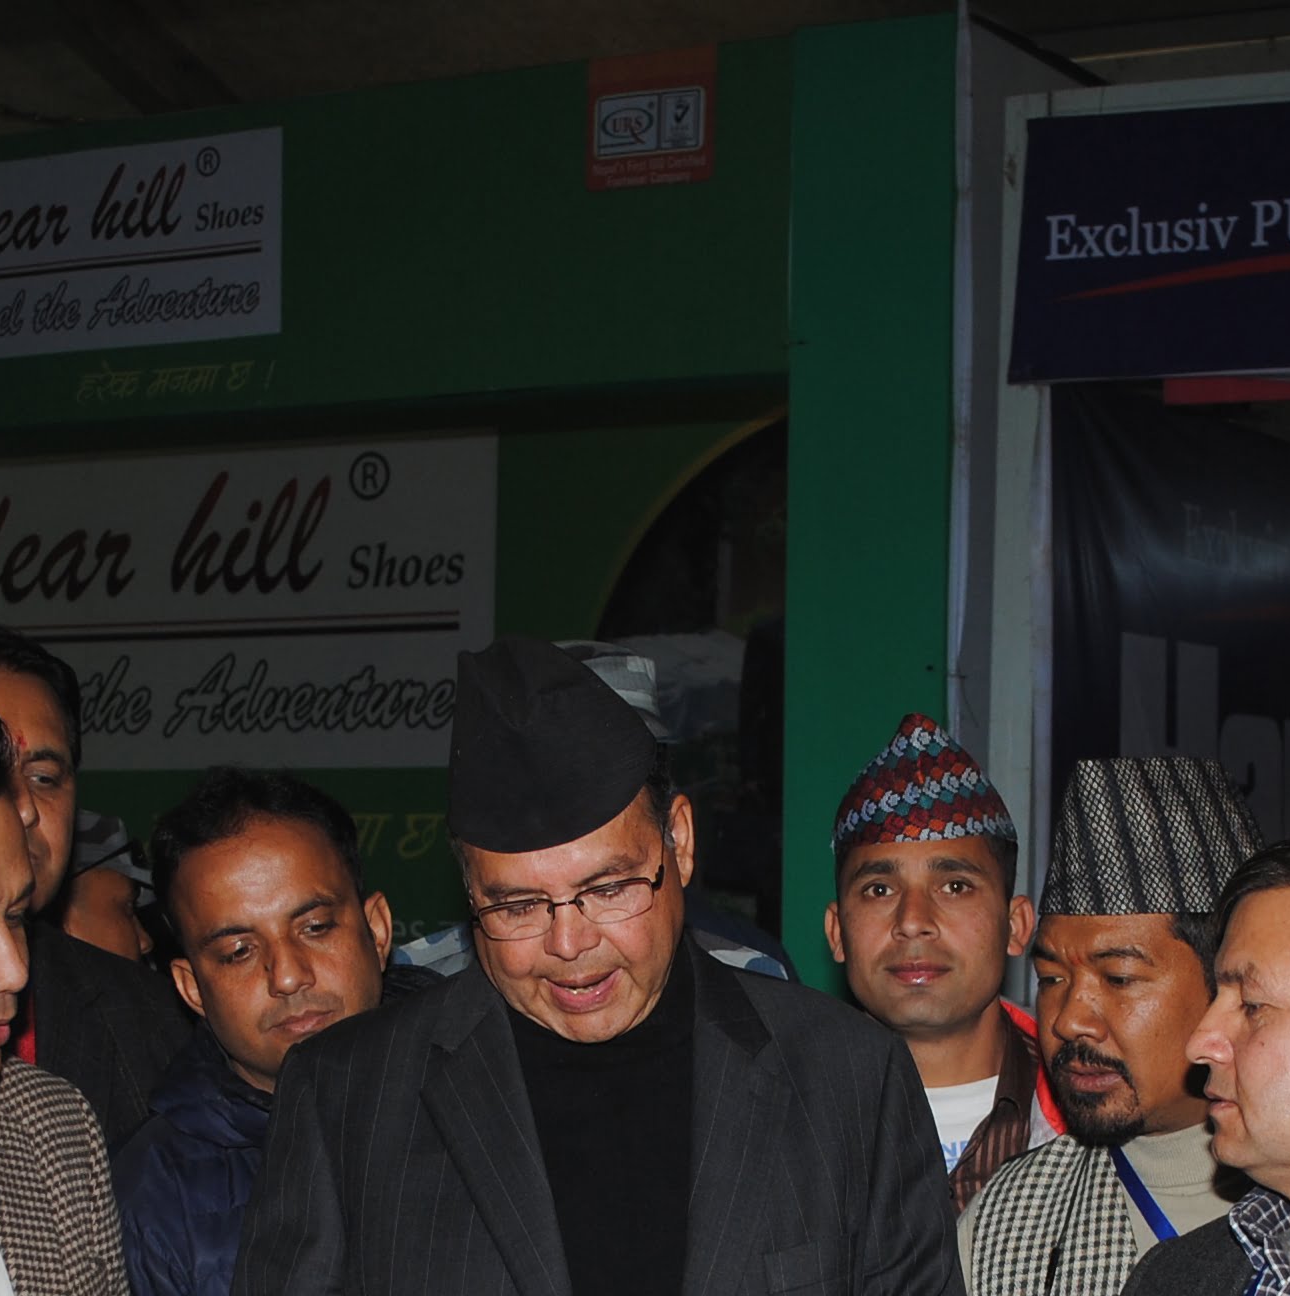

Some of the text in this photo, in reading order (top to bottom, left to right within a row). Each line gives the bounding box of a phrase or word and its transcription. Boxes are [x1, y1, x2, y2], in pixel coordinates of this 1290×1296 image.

[91, 163, 186, 240] hill
[195, 201, 265, 234] Shoes
[1045, 203, 1238, 262] Exclusiv
[32, 280, 82, 334] the
[87, 274, 262, 331] Adventure
[171, 472, 330, 595] hill
[347, 541, 465, 592] Shoes
[78, 652, 457, 738] the Adventure
